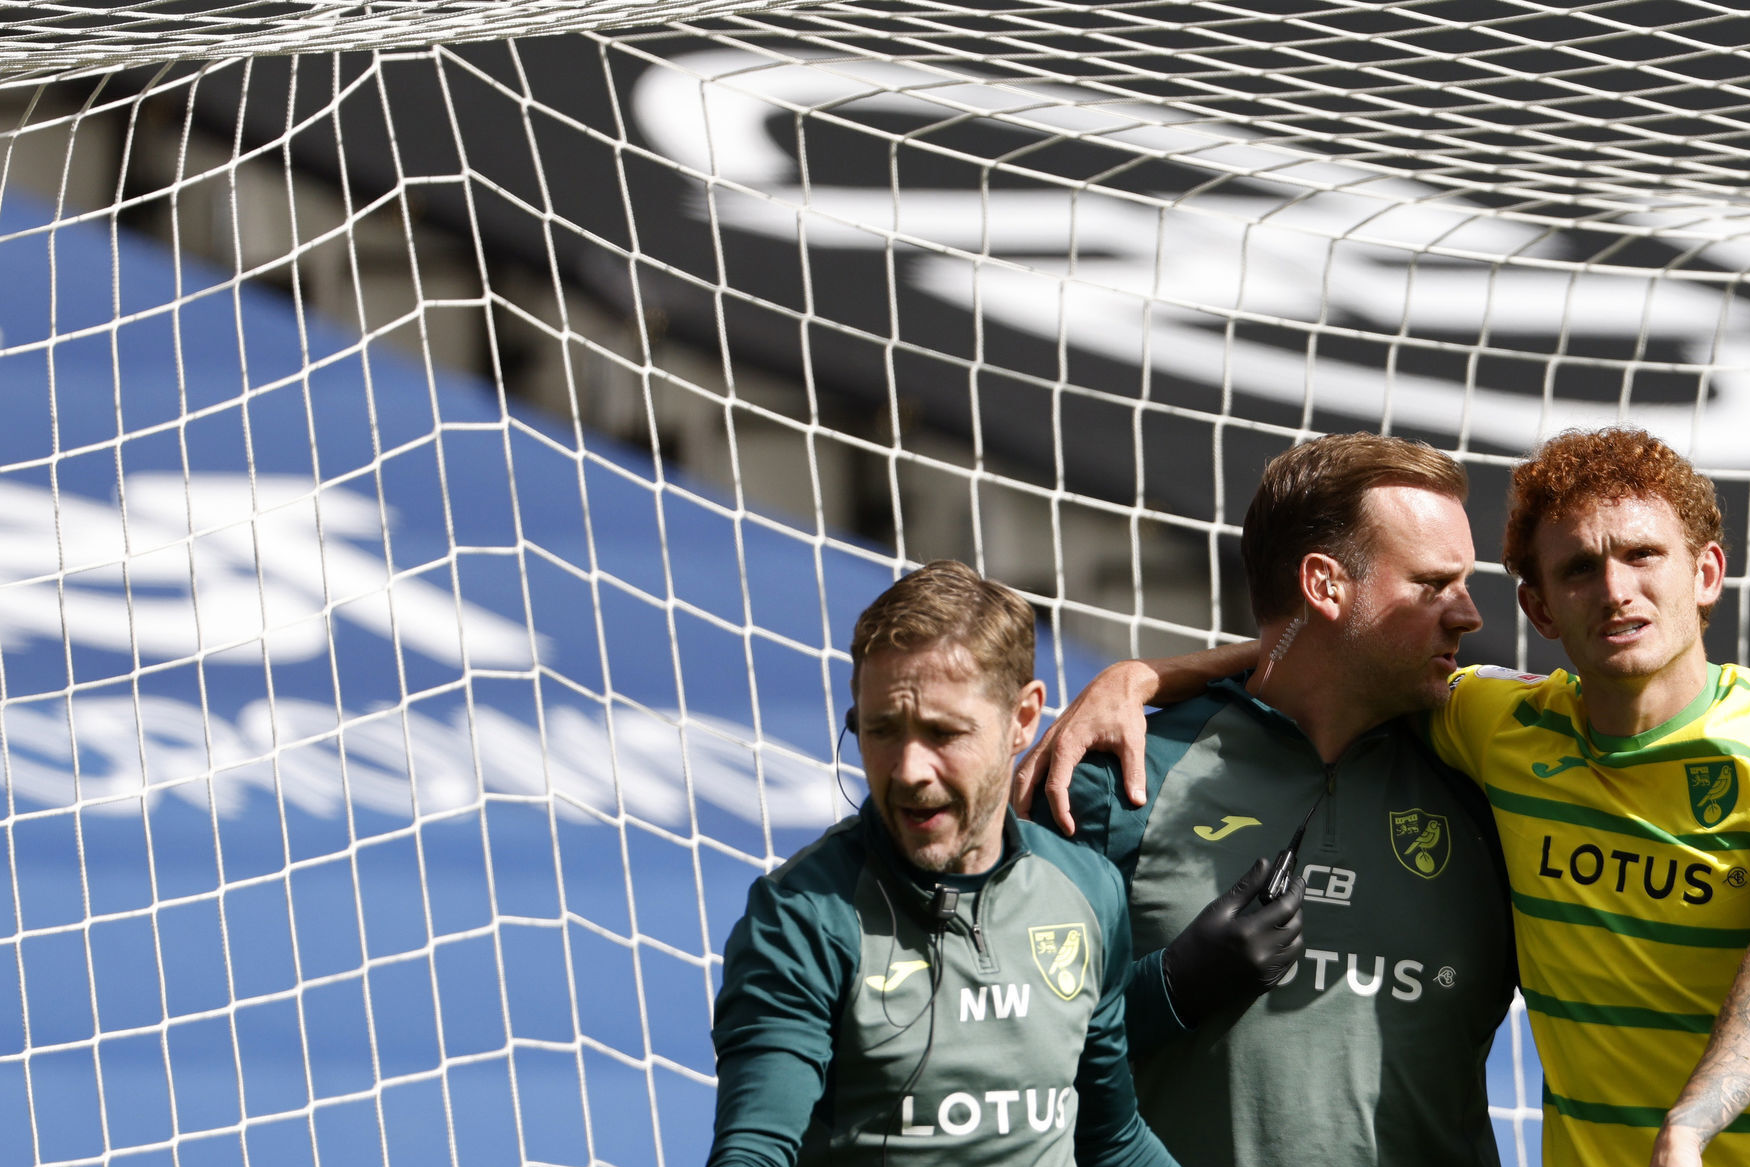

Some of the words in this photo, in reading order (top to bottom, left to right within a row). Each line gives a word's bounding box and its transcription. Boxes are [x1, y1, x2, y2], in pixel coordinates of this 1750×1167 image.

[1302, 863, 1357, 901] CB
[1539, 835, 1714, 905] LOTUS
[1277, 948, 1424, 1002] TUS
[959, 983, 1031, 1023] NW
